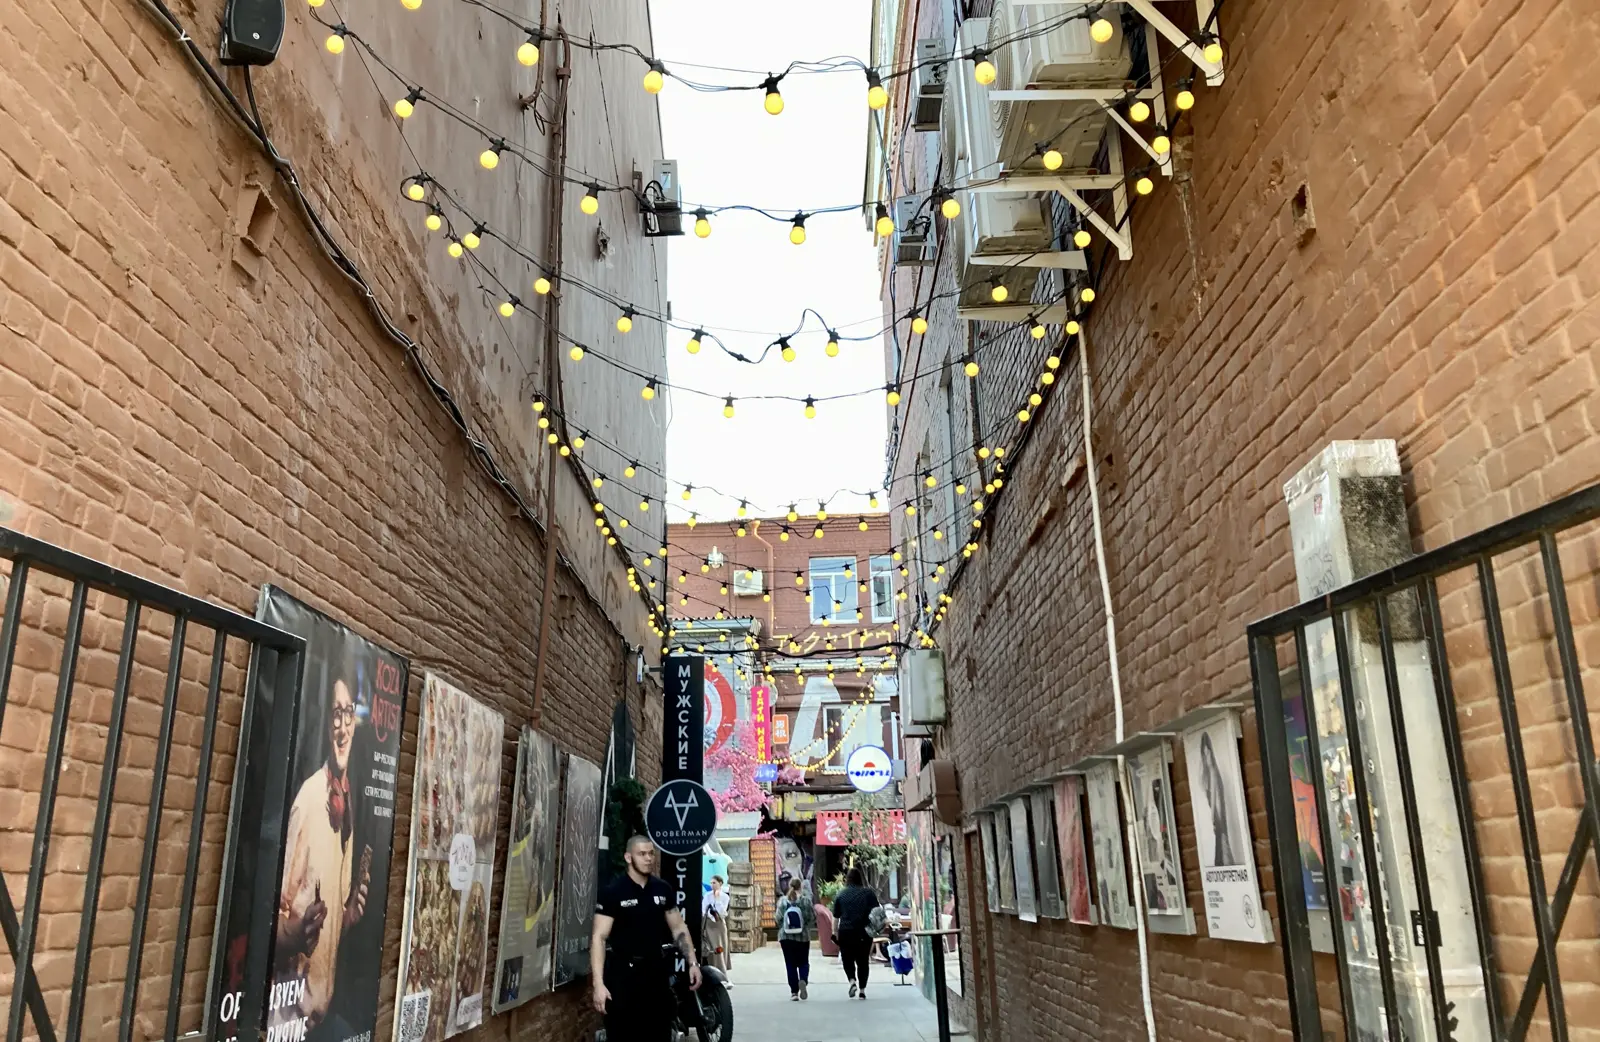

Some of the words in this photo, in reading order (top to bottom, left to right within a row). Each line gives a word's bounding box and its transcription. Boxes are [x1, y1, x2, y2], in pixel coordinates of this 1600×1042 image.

[376, 657, 400, 695] KOZA
[370, 694, 400, 743] ARTIST
[676, 664, 692, 770] МУЖСКИЕ
[655, 829, 708, 838] DOBERMAN
